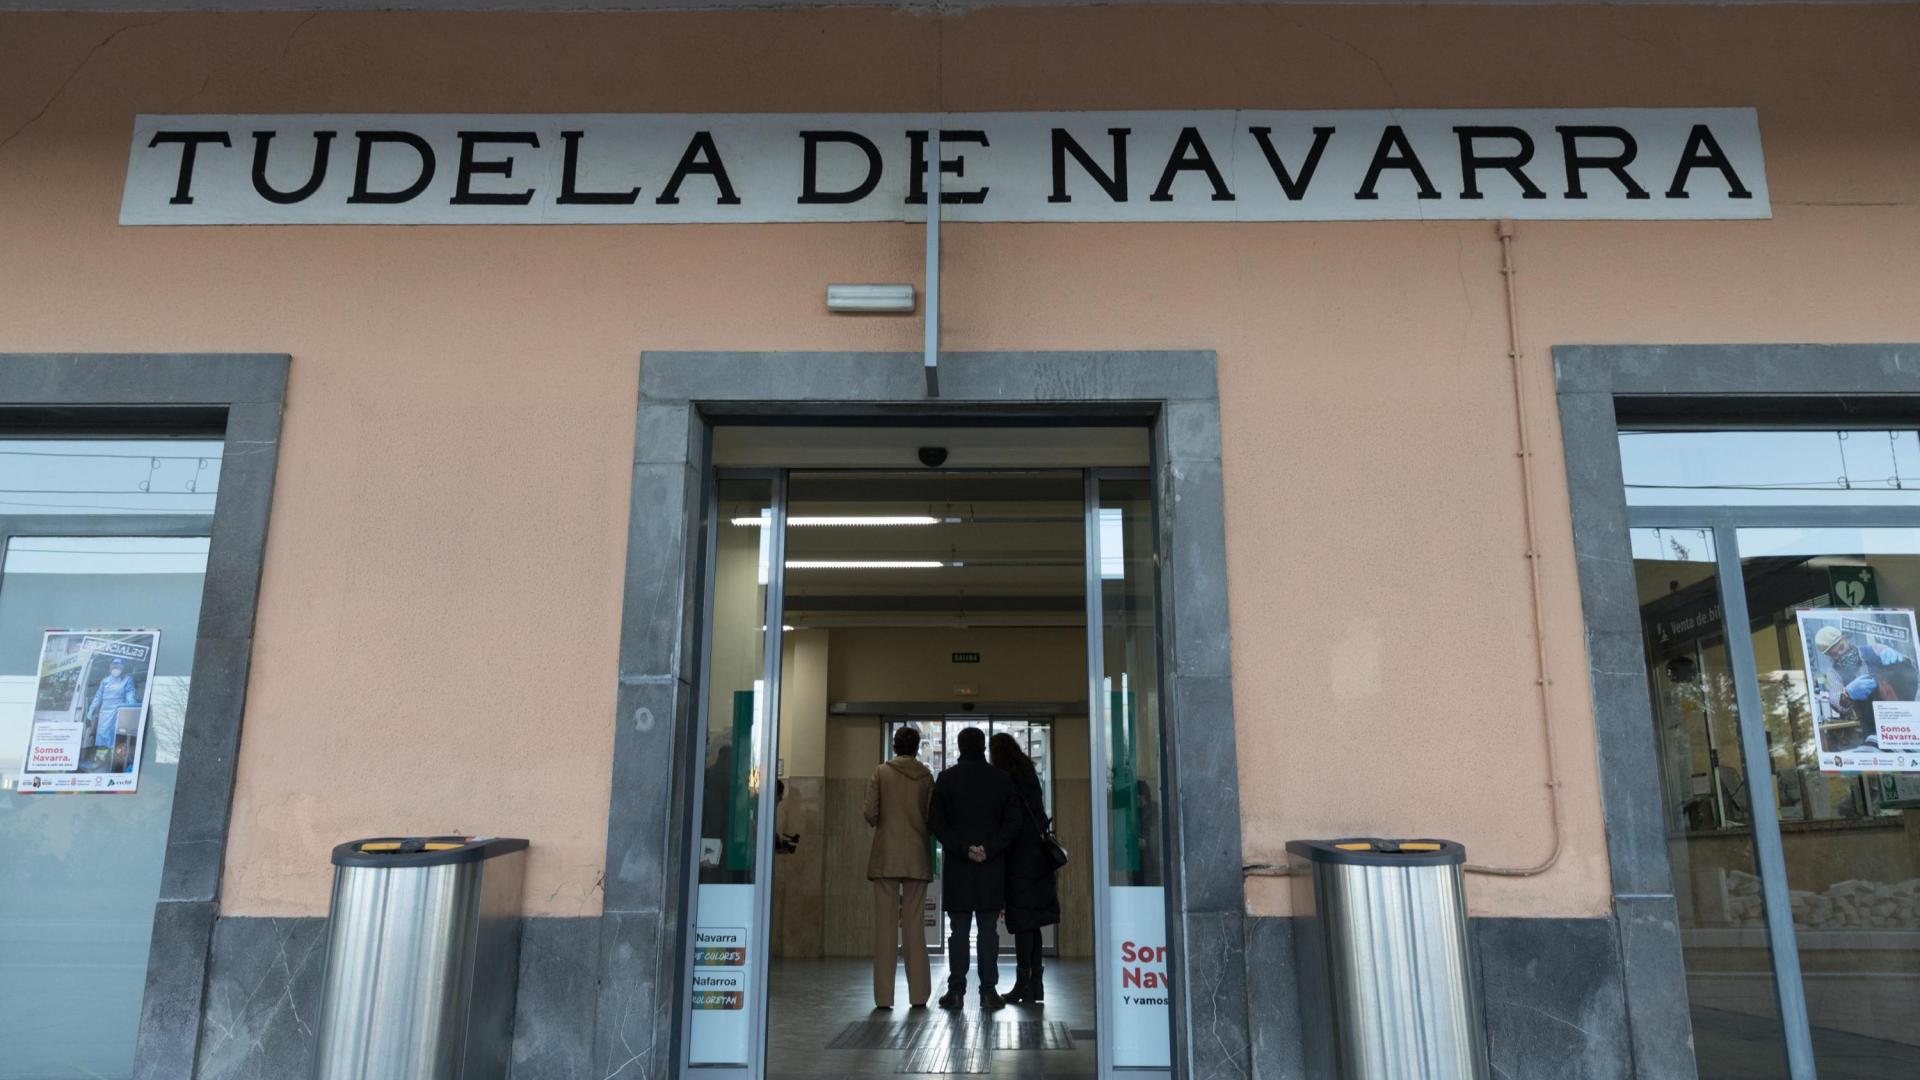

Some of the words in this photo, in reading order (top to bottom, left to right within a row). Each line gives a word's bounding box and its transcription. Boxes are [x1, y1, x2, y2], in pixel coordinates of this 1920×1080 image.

[148, 130, 741, 206] TUDELA
[797, 129, 990, 206] DE
[1047, 124, 1753, 204] NAVARRA
[1670, 617, 1695, 635] Venta
[1696, 611, 1707, 626] de
[1881, 733, 1920, 741] Navarra.
[33, 746, 64, 754] Somos
[32, 754, 71, 762] Navarra.
[696, 933, 737, 943] Navarra
[693, 976, 737, 986] Nafarroa
[1123, 996, 1131, 1005] Y
[1133, 997, 1169, 1005] vamos
